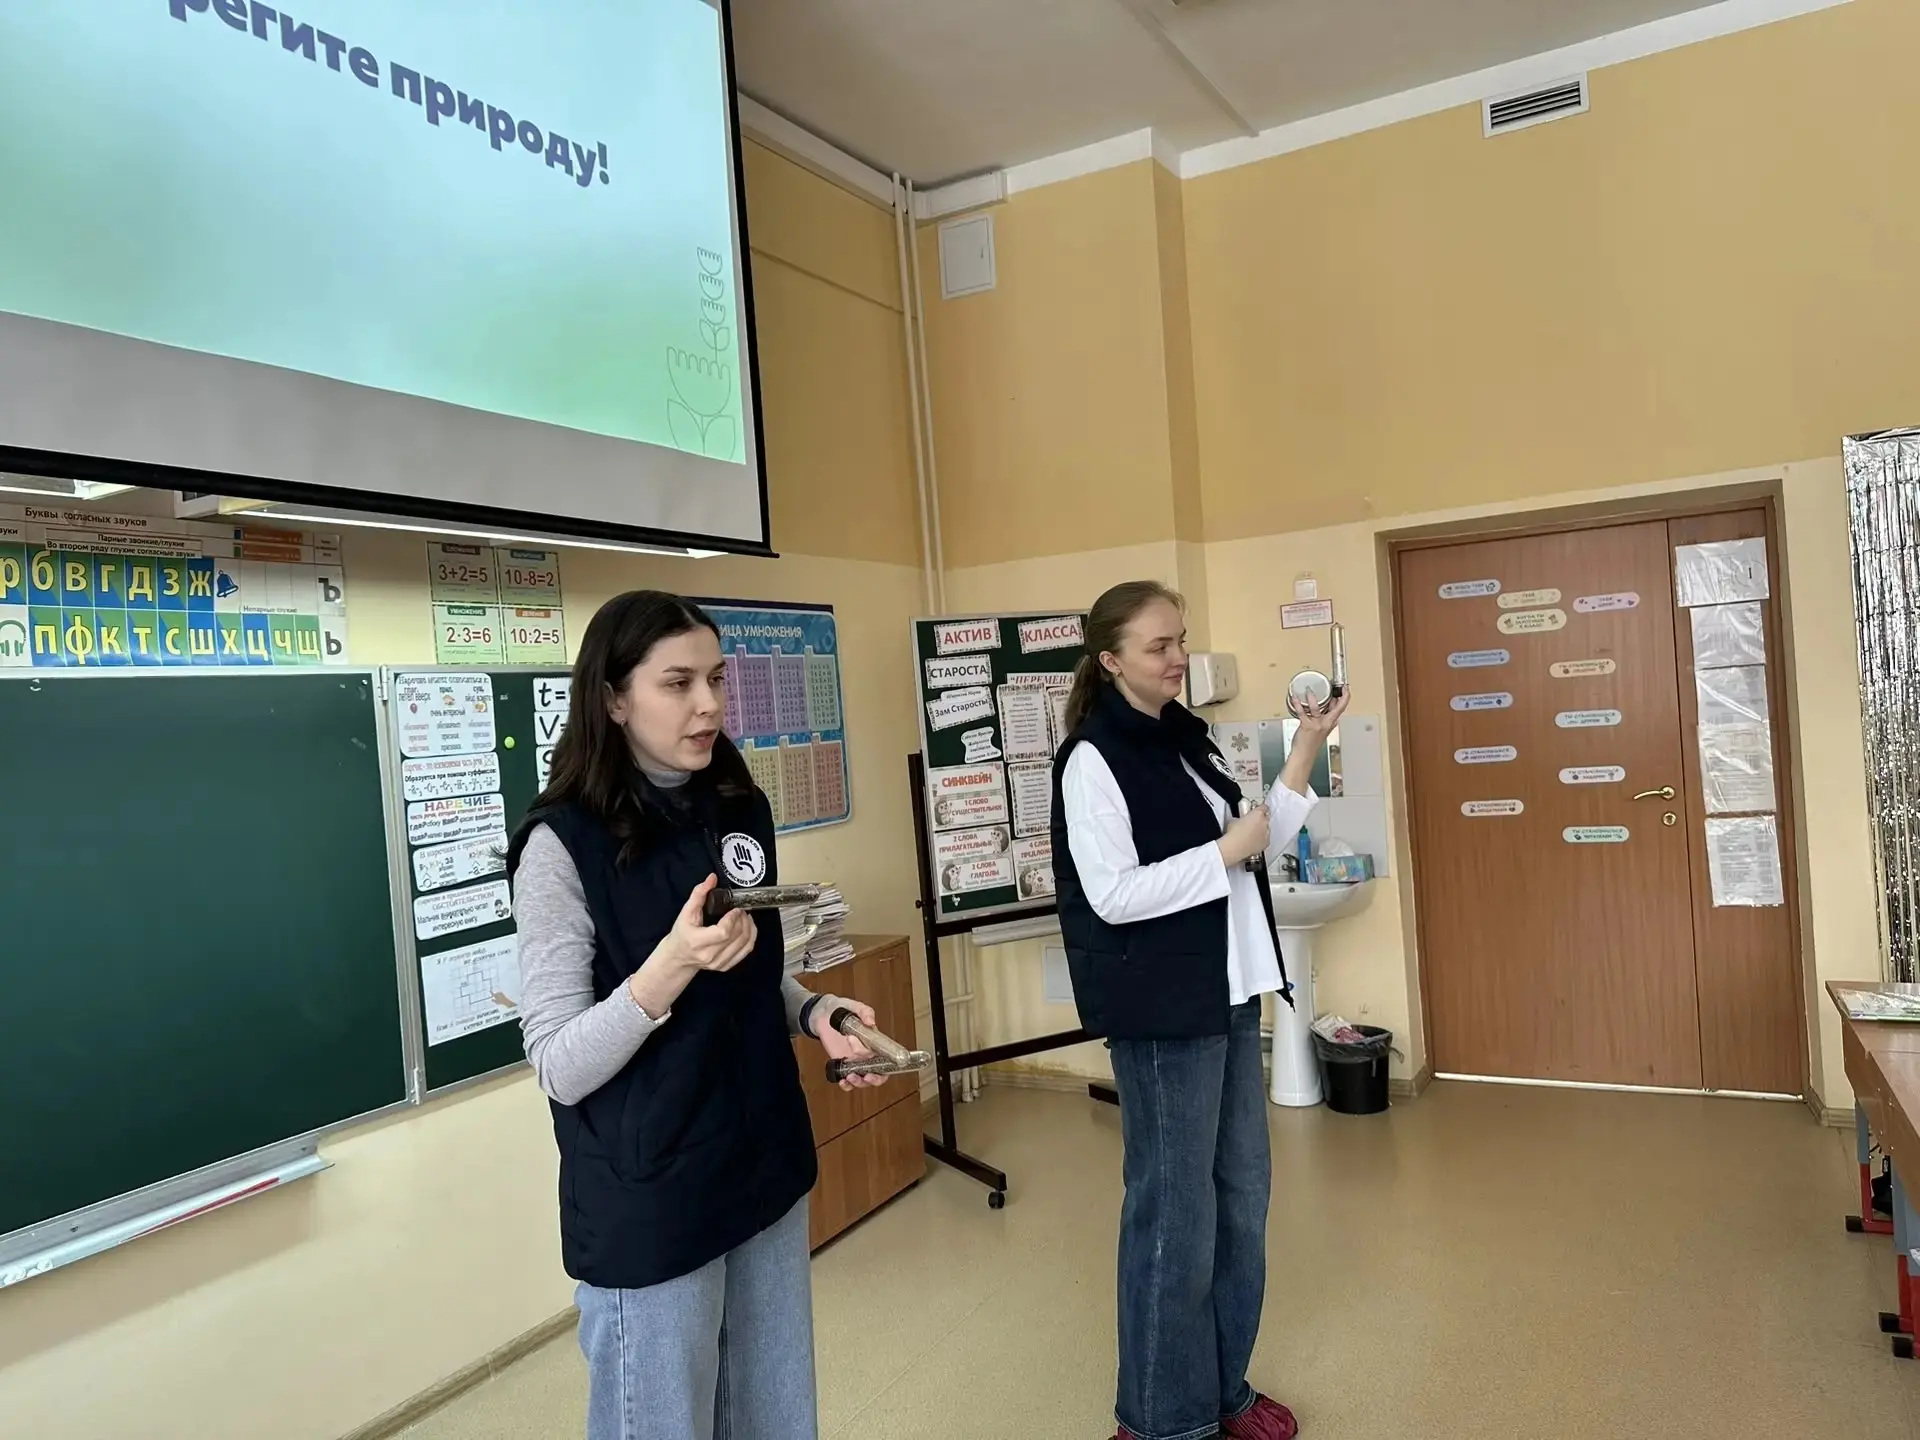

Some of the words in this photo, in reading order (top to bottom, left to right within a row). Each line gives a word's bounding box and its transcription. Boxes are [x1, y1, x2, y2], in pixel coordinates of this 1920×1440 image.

[390, 61, 609, 188] природу!
[25, 507, 58, 519] Буквы
[63, 511, 111, 524] согласных
[113, 517, 147, 527] звуков
[46, 541, 58, 549] Во
[59, 543, 89, 551] втором
[90, 545, 108, 553] ряду
[97, 534, 128, 543] Парные
[31, 548, 55, 591] б
[64, 560, 88, 592] в
[100, 563, 117, 593] г
[128, 566, 154, 602] д
[162, 567, 181, 596] з
[188, 569, 213, 598] ж
[438, 564, 488, 583] 3+2=5
[505, 569, 555, 587] 10-8=2
[34, 625, 57, 655] п
[64, 614, 94, 666] ф
[101, 625, 122, 656] к
[132, 626, 153, 656] т
[164, 627, 181, 656] с
[189, 627, 214, 656] ш
[219, 629, 241, 656] х
[246, 628, 269, 661] ц
[273, 628, 293, 656] ч
[296, 629, 321, 661] щ
[511, 628, 560, 645] 10:2=5
[743, 625, 802, 638] УМНОЖЕНИЯ
[944, 627, 992, 644] АКТИВ
[1024, 624, 1079, 643] КЛАССА
[930, 664, 988, 679] СТАРОСТА
[934, 708, 951, 718] Зам
[951, 699, 988, 713] Старосты
[942, 771, 992, 788] СИНКВЕЙН
[424, 796, 491, 812] НАРЕЧИЕ
[968, 798, 989, 806] СЛОВО
[957, 833, 978, 841] СЛОВА
[976, 861, 997, 869] СЛОВА
